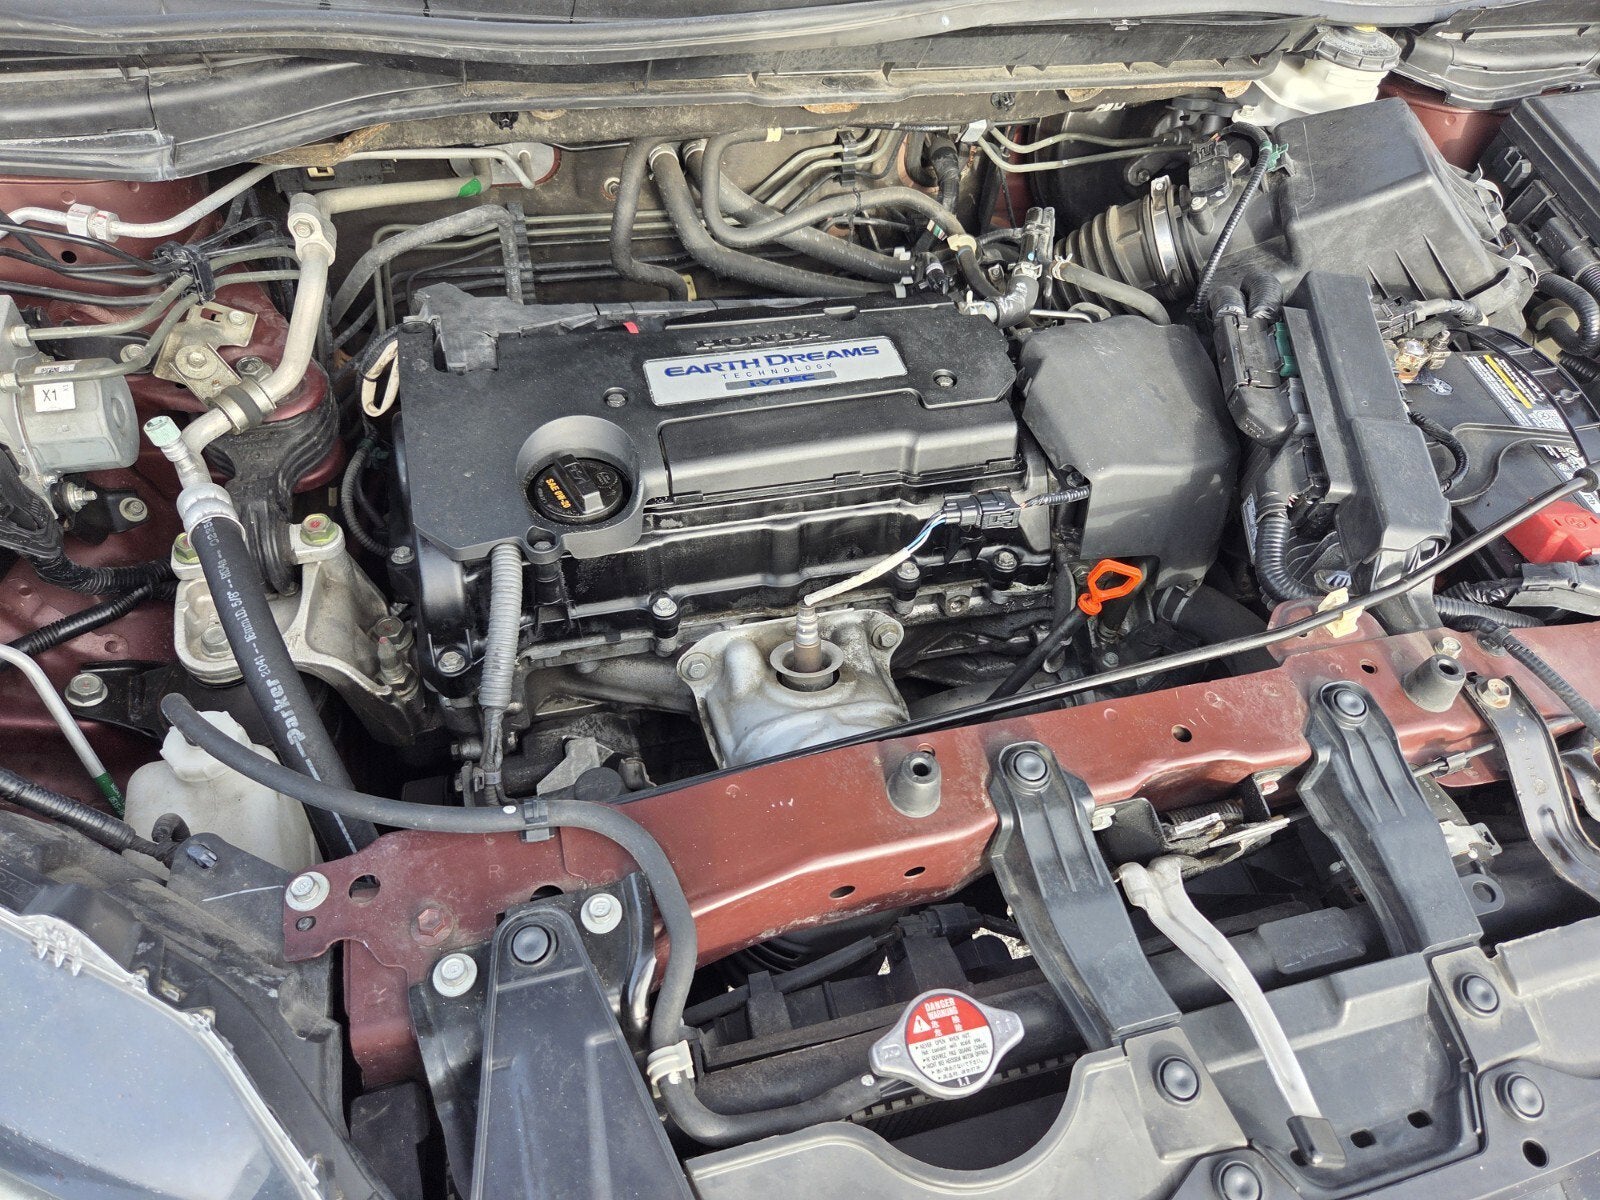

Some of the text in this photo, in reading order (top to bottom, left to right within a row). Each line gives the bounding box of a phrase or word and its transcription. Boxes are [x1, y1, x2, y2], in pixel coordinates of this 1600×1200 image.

[695, 331, 832, 351] HONDA
[664, 345, 880, 377] EARTH DREAMS
[722, 362, 834, 380] TECHNOLOGY
[42, 389, 58, 402] X1
[545, 478, 559, 492] SAE
[253, 654, 271, 677] 2041
[266, 678, 306, 745] Parker
[924, 997, 956, 1012] DANGER
